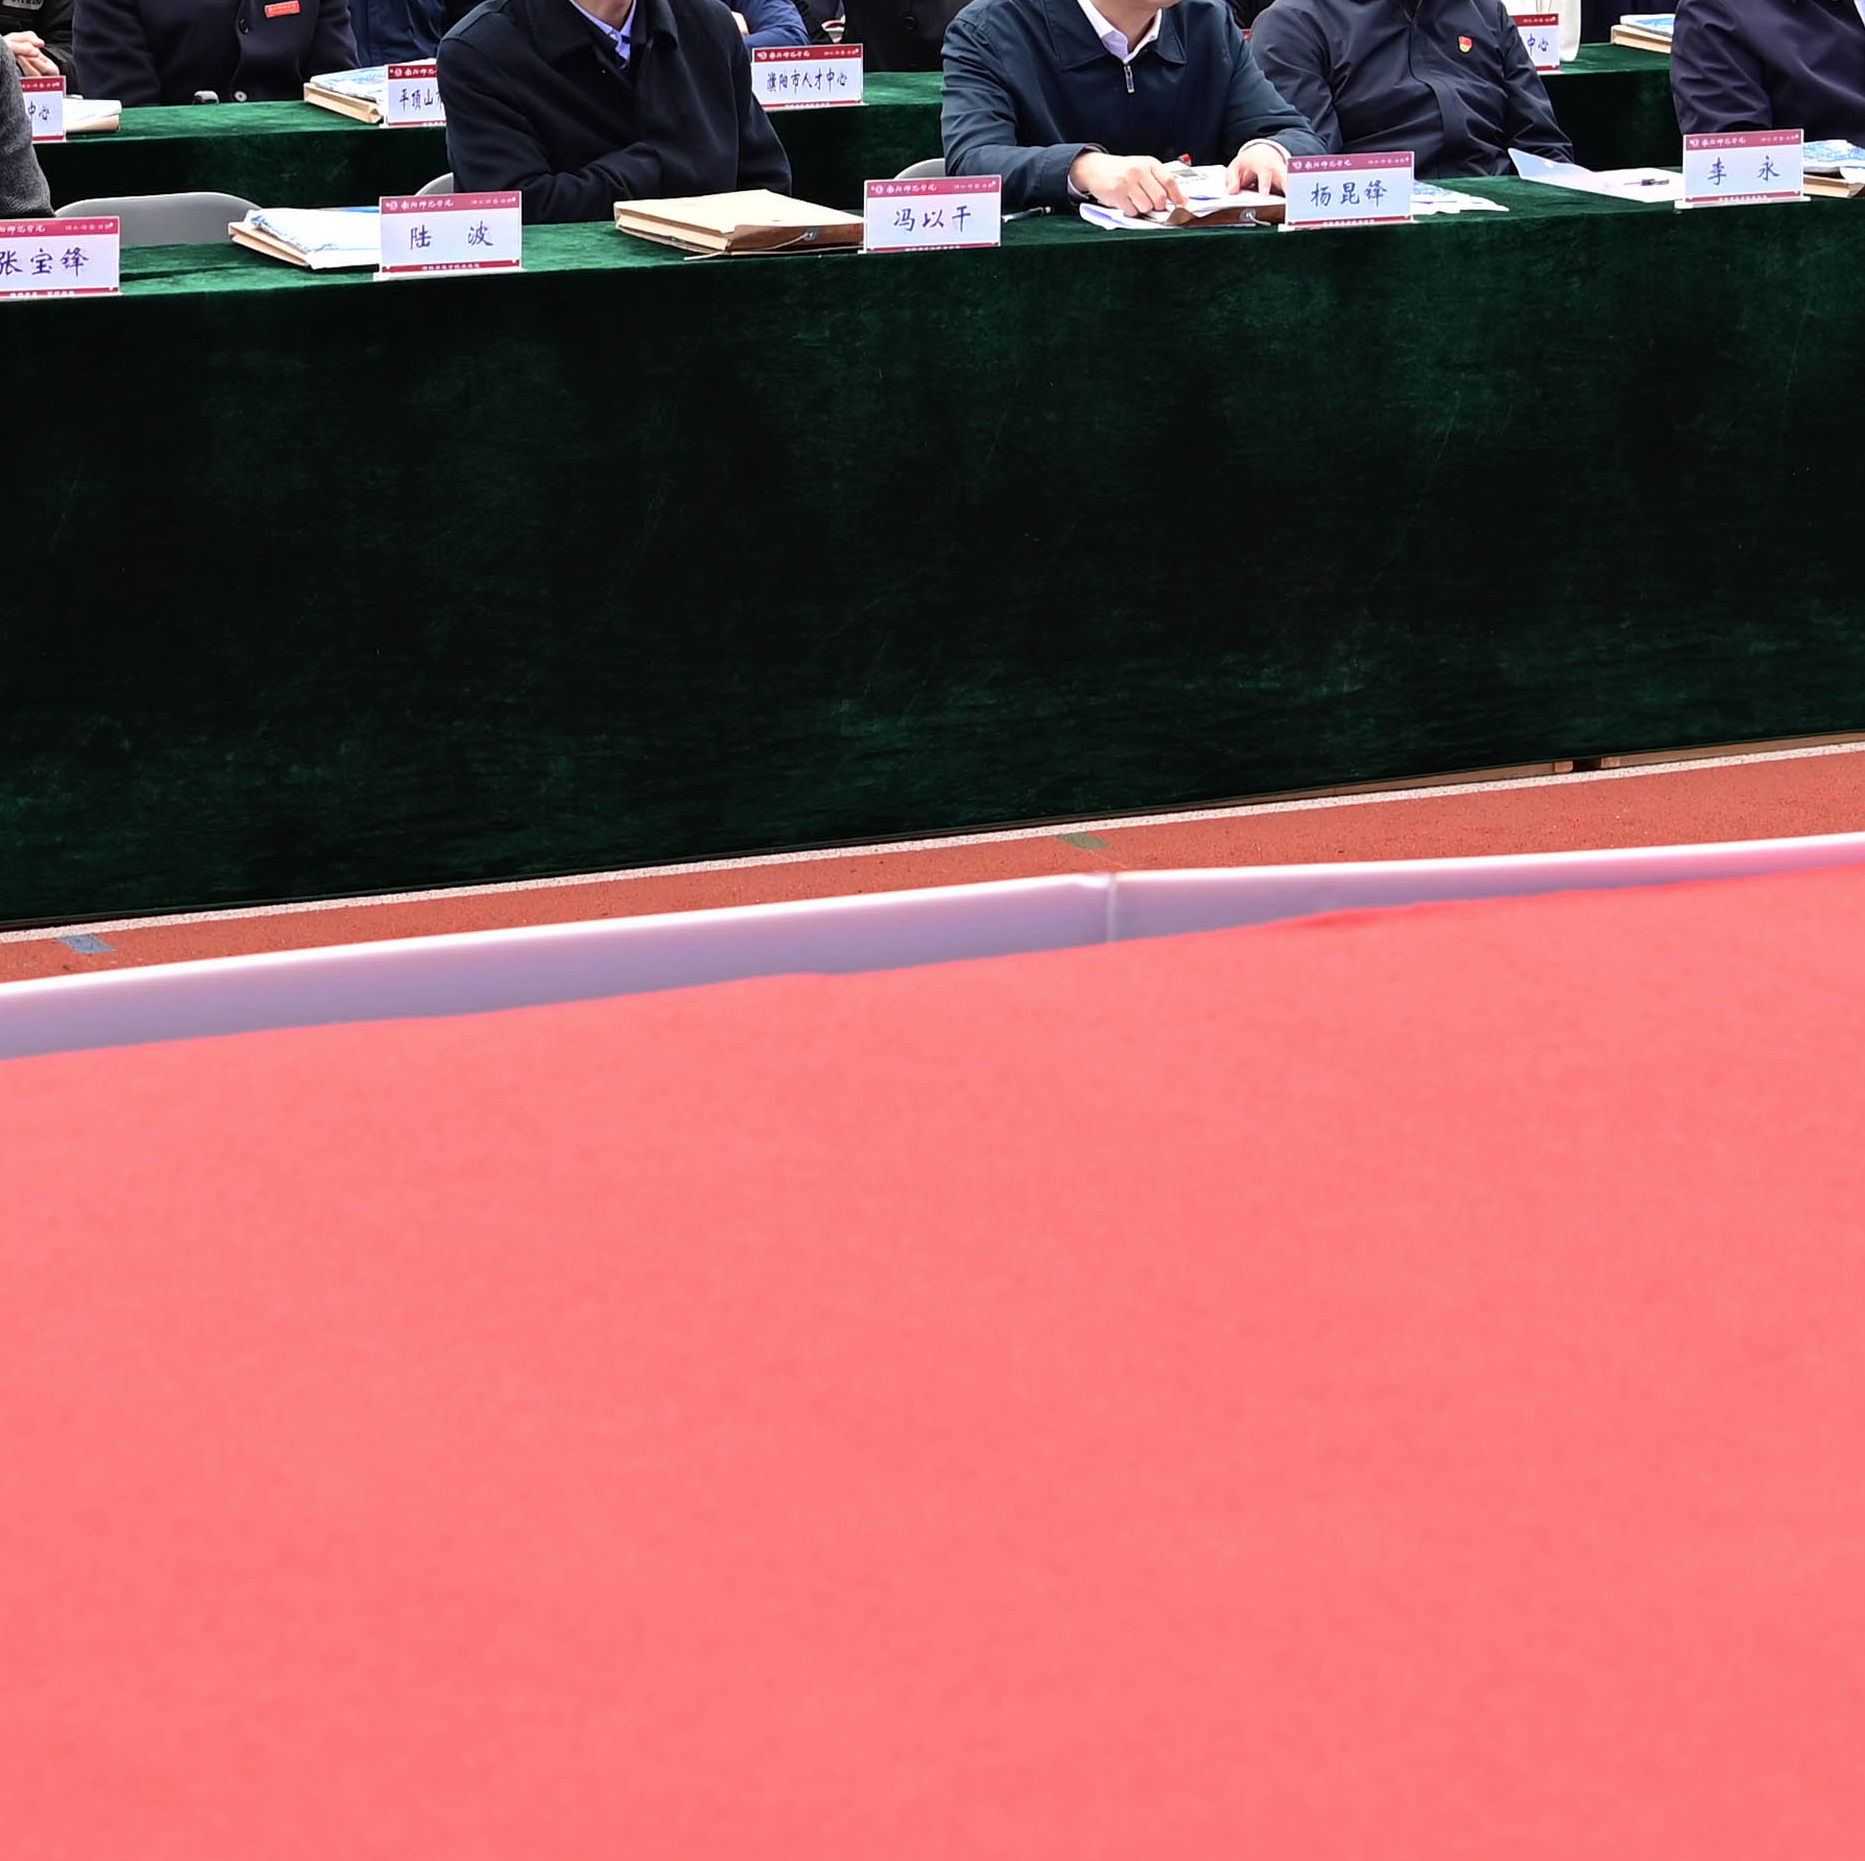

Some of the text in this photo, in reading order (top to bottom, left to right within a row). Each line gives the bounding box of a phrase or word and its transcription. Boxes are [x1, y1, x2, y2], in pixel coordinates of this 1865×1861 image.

[766, 67, 848, 94] 濮阳市人才中心
[1310, 179, 1388, 207] 杨昆锋
